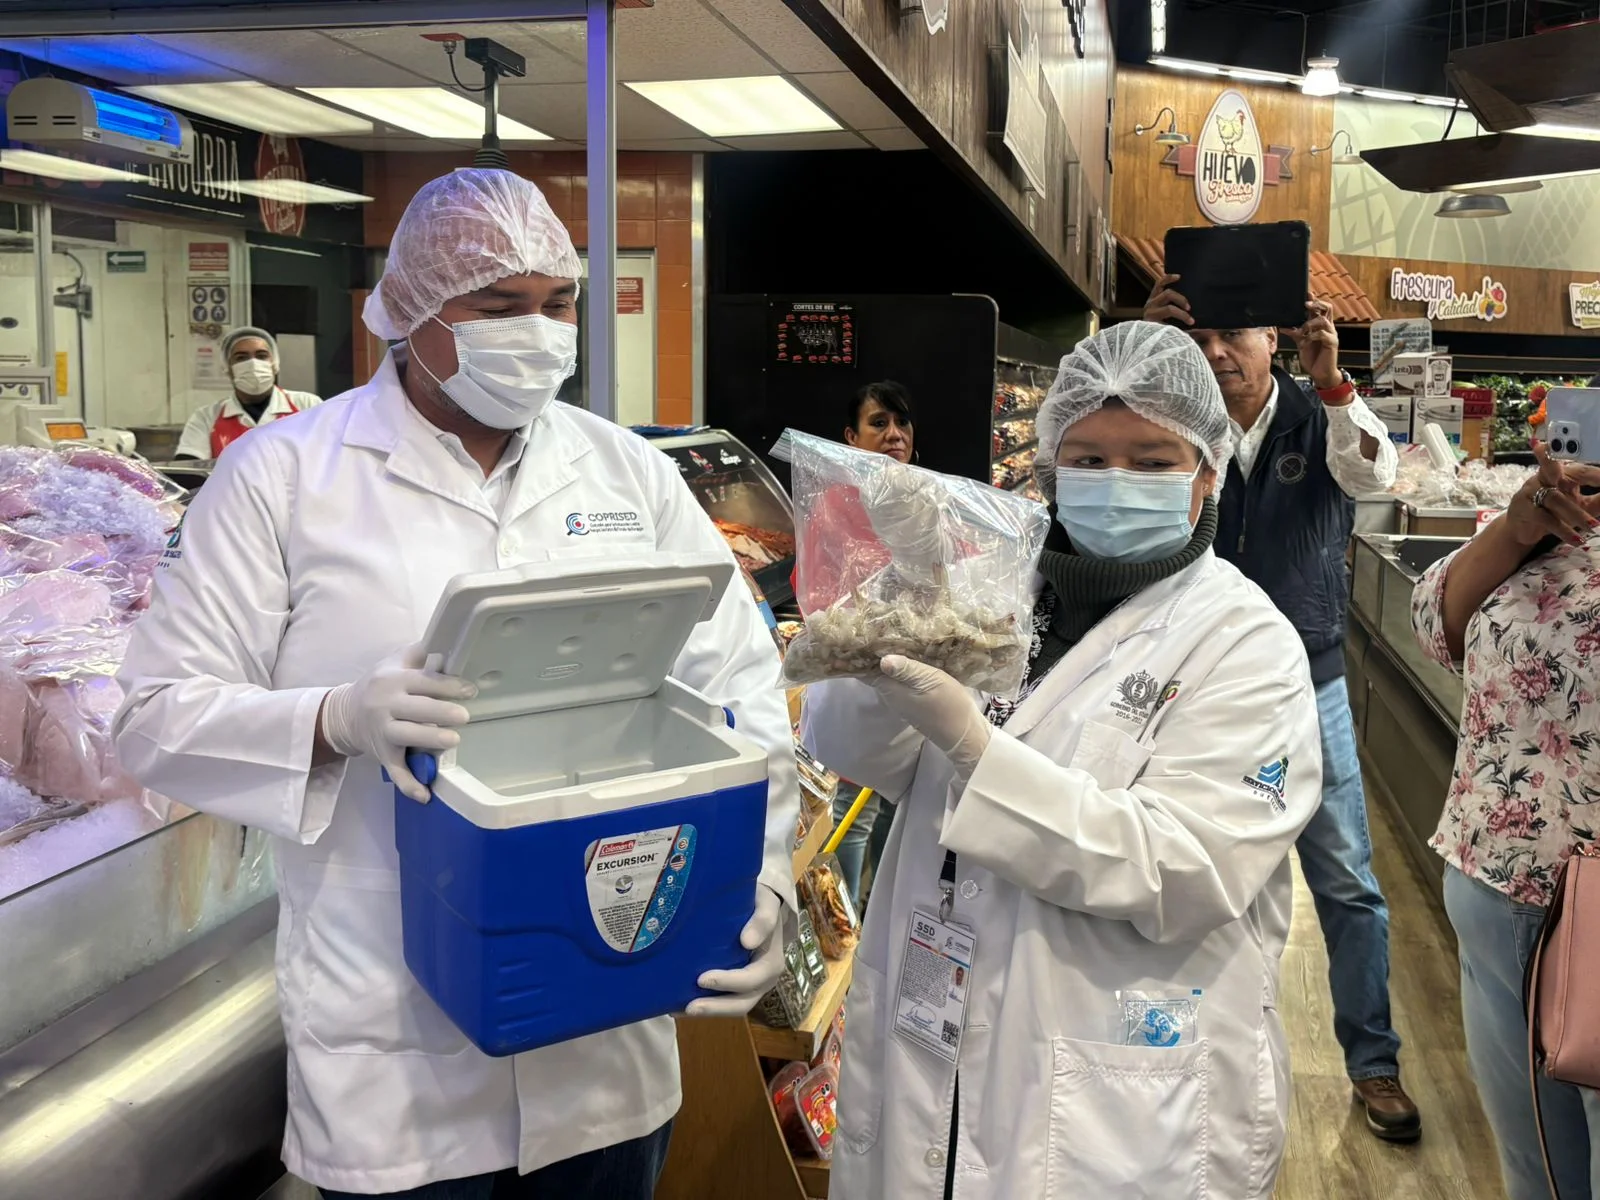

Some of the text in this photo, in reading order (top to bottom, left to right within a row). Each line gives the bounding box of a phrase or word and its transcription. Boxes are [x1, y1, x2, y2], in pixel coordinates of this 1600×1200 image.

[1203, 151, 1256, 185] HUEVO
[1392, 271, 1453, 300] Frescura
[1438, 295, 1478, 317] Calidad
[1575, 300, 1600, 315] PREC
[588, 511, 637, 522] COPRISED
[597, 854, 655, 871] EXCURSION
[916, 921, 936, 937] SSD
